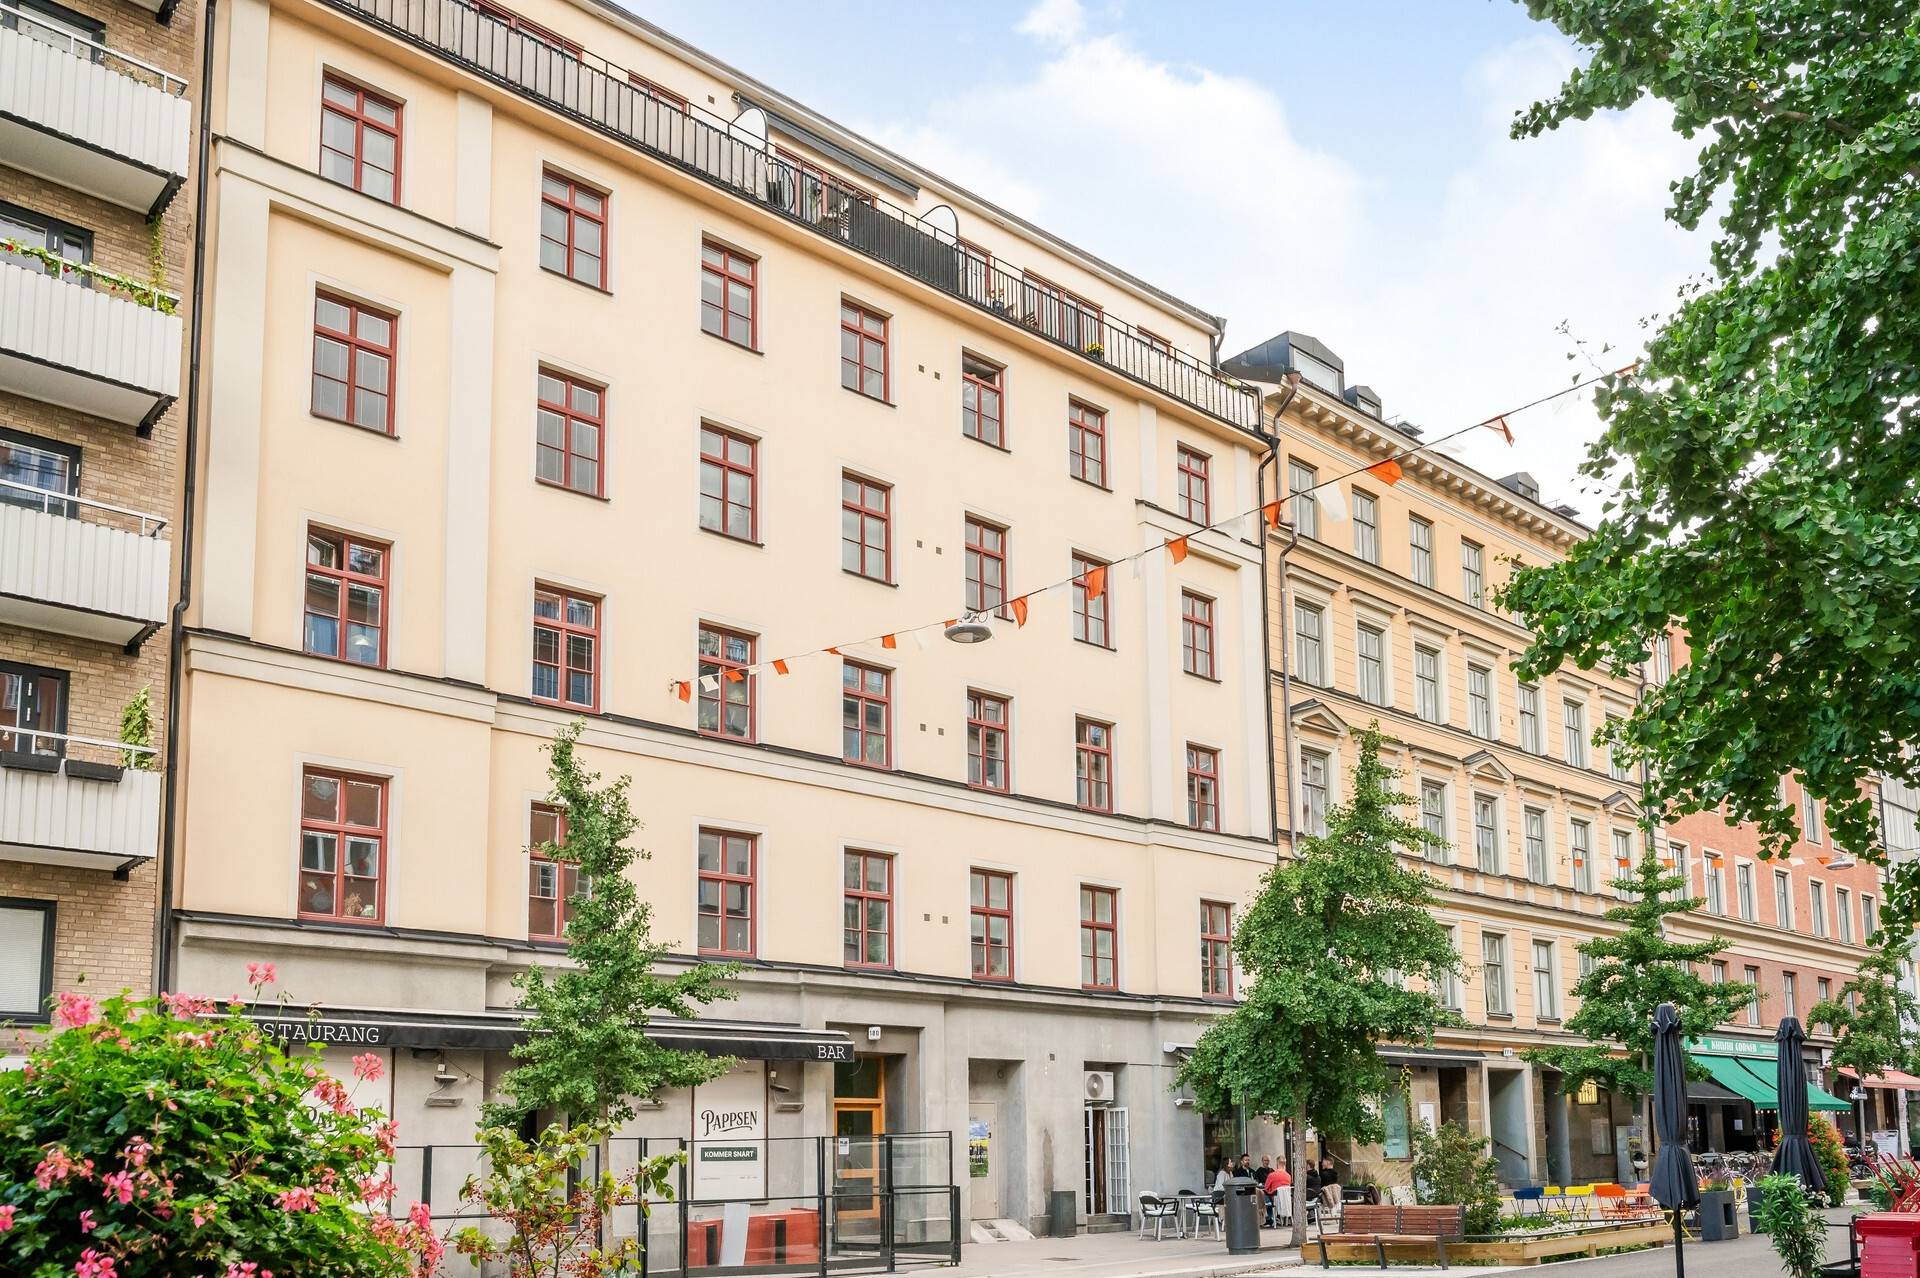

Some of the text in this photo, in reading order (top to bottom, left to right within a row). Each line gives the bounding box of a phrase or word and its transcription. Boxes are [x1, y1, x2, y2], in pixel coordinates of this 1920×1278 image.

[252, 1022, 380, 1043] STAURANG
[817, 1045, 846, 1059] BAR
[704, 1150, 754, 1158] KOMMER SNART
